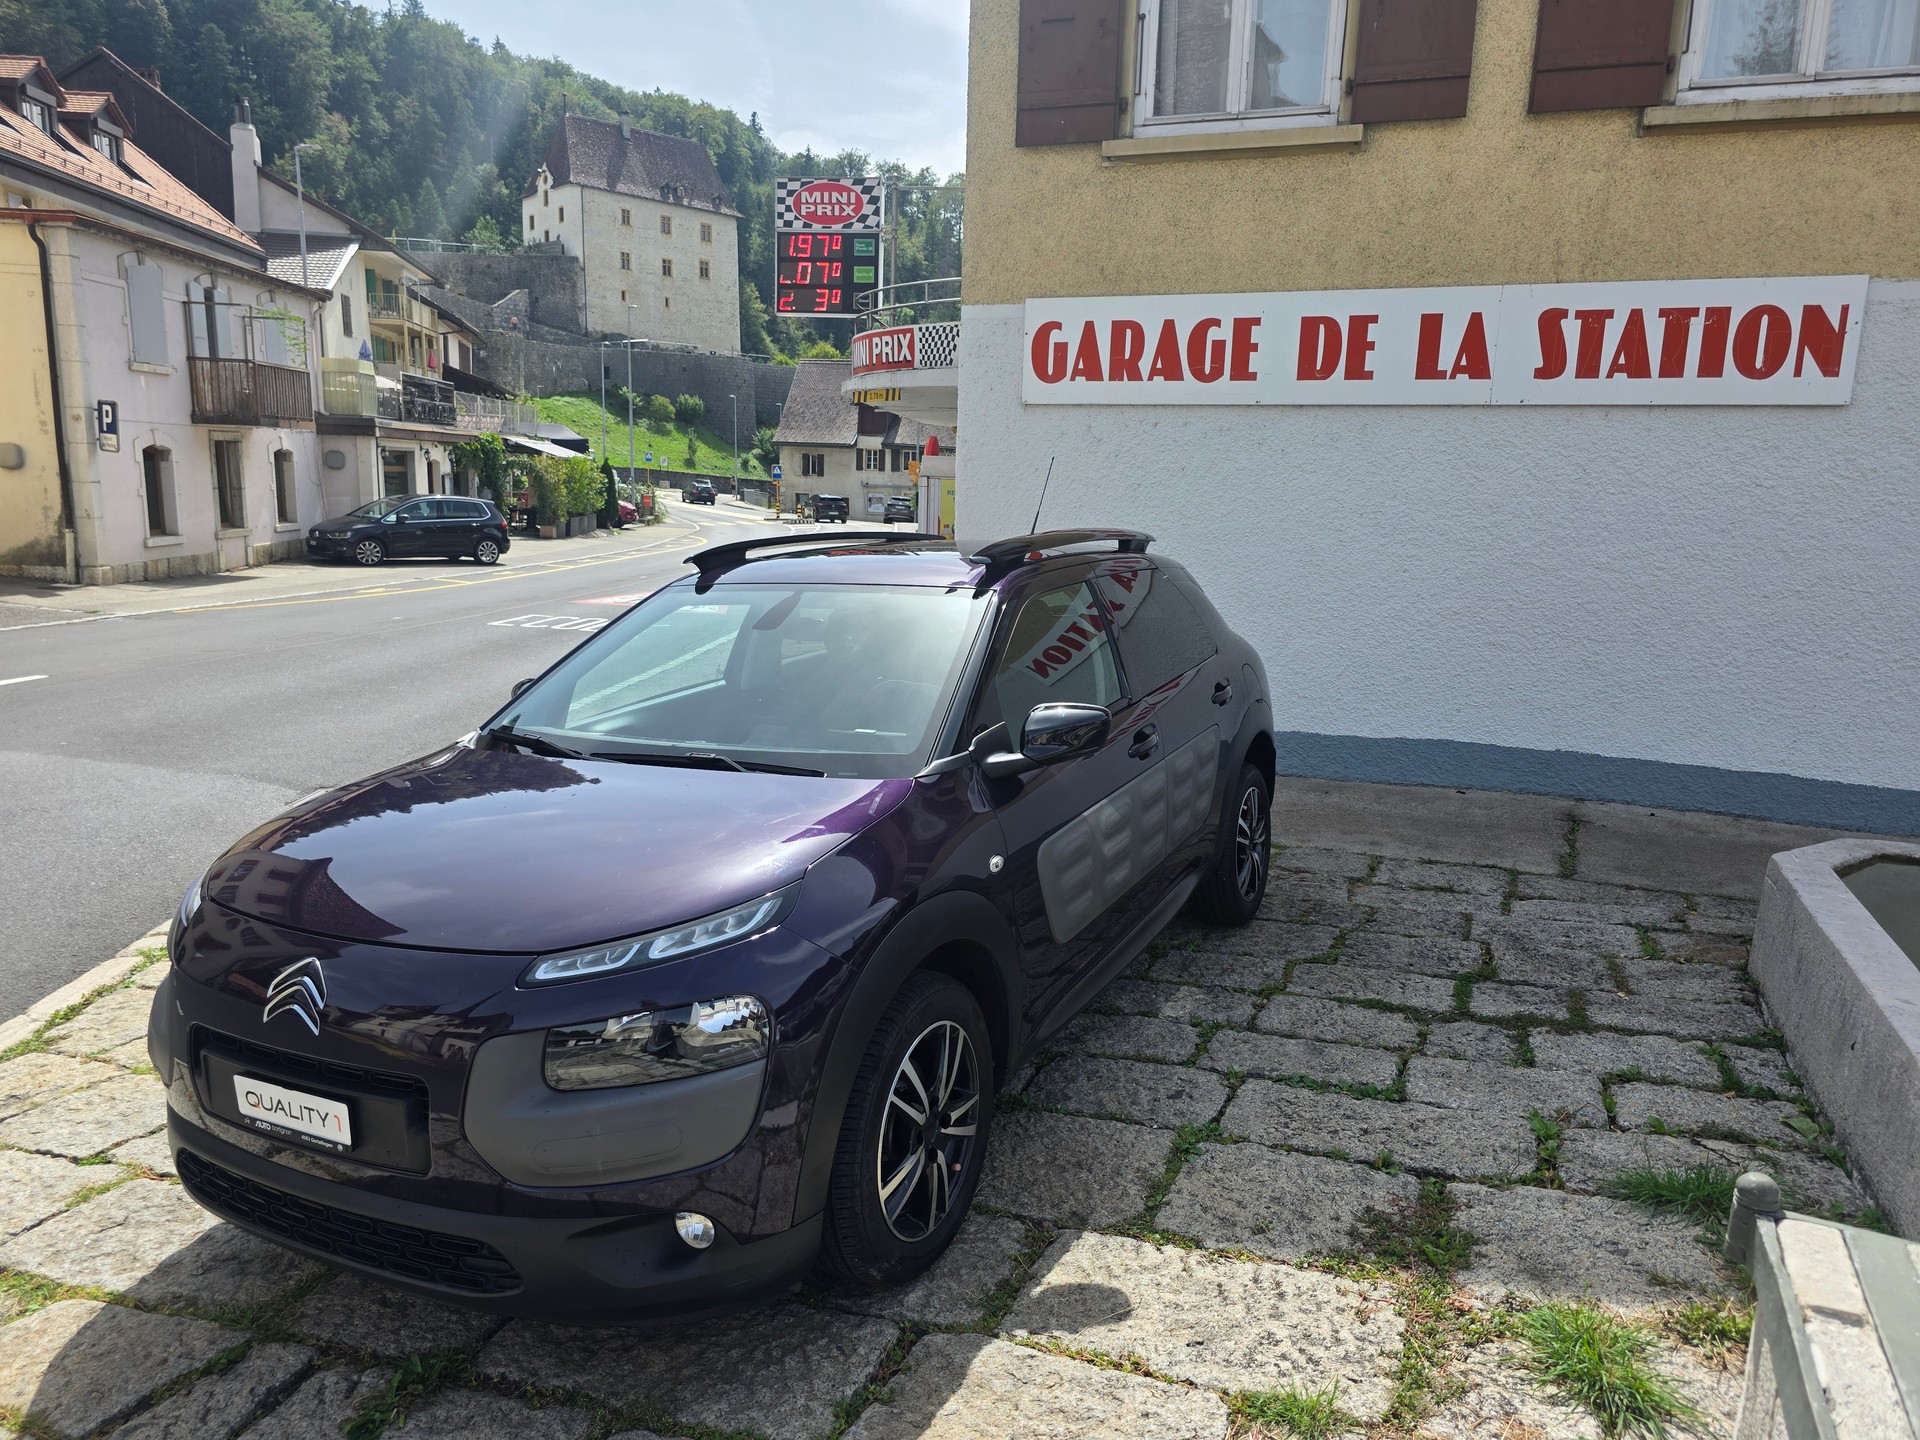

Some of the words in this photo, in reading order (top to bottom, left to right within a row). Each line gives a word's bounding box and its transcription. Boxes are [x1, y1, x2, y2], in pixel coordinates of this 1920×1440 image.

[801, 191, 856, 204] MINI
[801, 204, 857, 217] PRIX
[872, 332, 912, 364] PRIX
[1031, 317, 1262, 384] GARAGE
[1296, 314, 1380, 381] DE
[1414, 311, 1492, 380] LA
[1533, 303, 1851, 380] STATION
[102, 404, 113, 431] P
